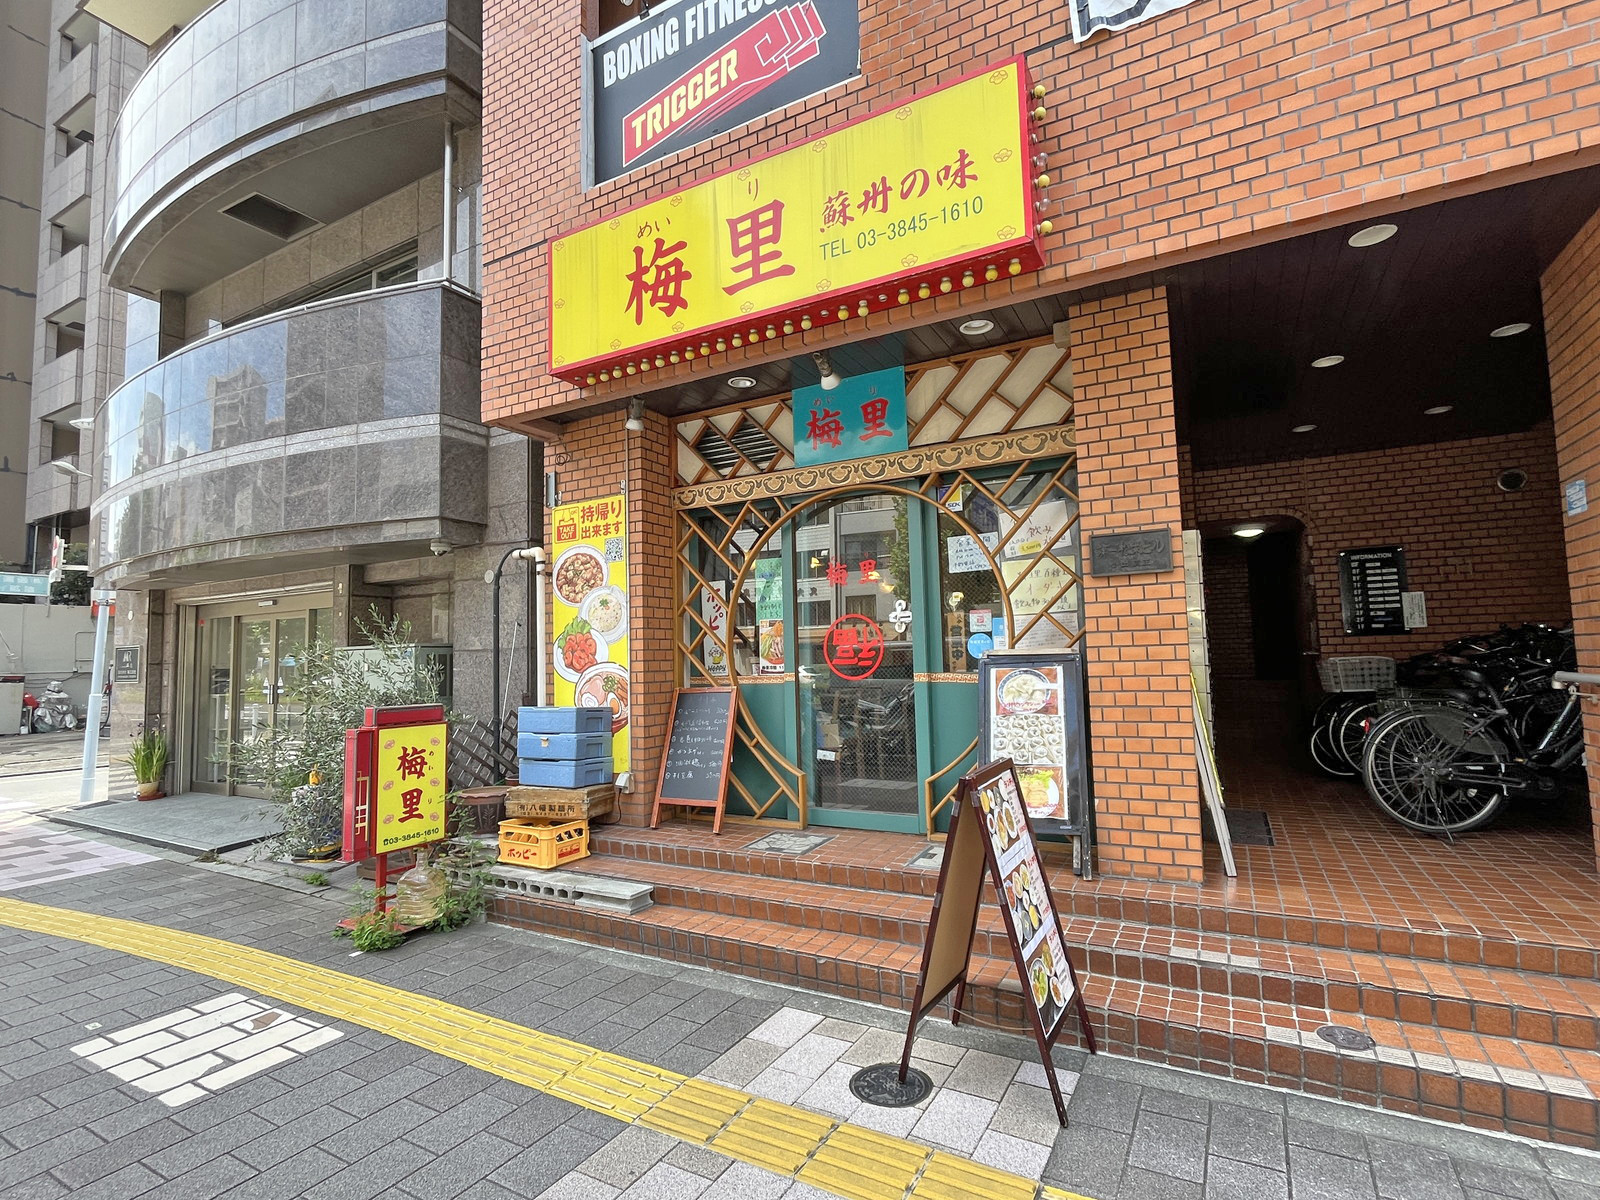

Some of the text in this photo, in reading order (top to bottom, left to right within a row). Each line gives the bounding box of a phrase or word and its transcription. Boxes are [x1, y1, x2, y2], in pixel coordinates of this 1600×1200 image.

[603, 0, 777, 88] BOXING FITNE
[631, 48, 739, 149] TRIGGER
[747, 178, 760, 201] り
[637, 216, 671, 240] めい
[819, 195, 983, 261] TEL 03-3845-1610
[624, 199, 796, 326] 梅里
[806, 398, 893, 451] 梅里
[580, 499, 622, 524] 持帰り
[559, 525, 575, 533] TAKE
[560, 531, 574, 540] OUT
[581, 520, 623, 540] 出来ます
[1350, 552, 1392, 560] INFORMATION
[826, 558, 880, 588] 梅里
[706, 588, 723, 646] ホッピ
[832, 626, 880, 667] 福
[396, 746, 428, 824] 梅里
[388, 827, 440, 845] 03-3845-1610
[507, 848, 537, 860] ホッピー
